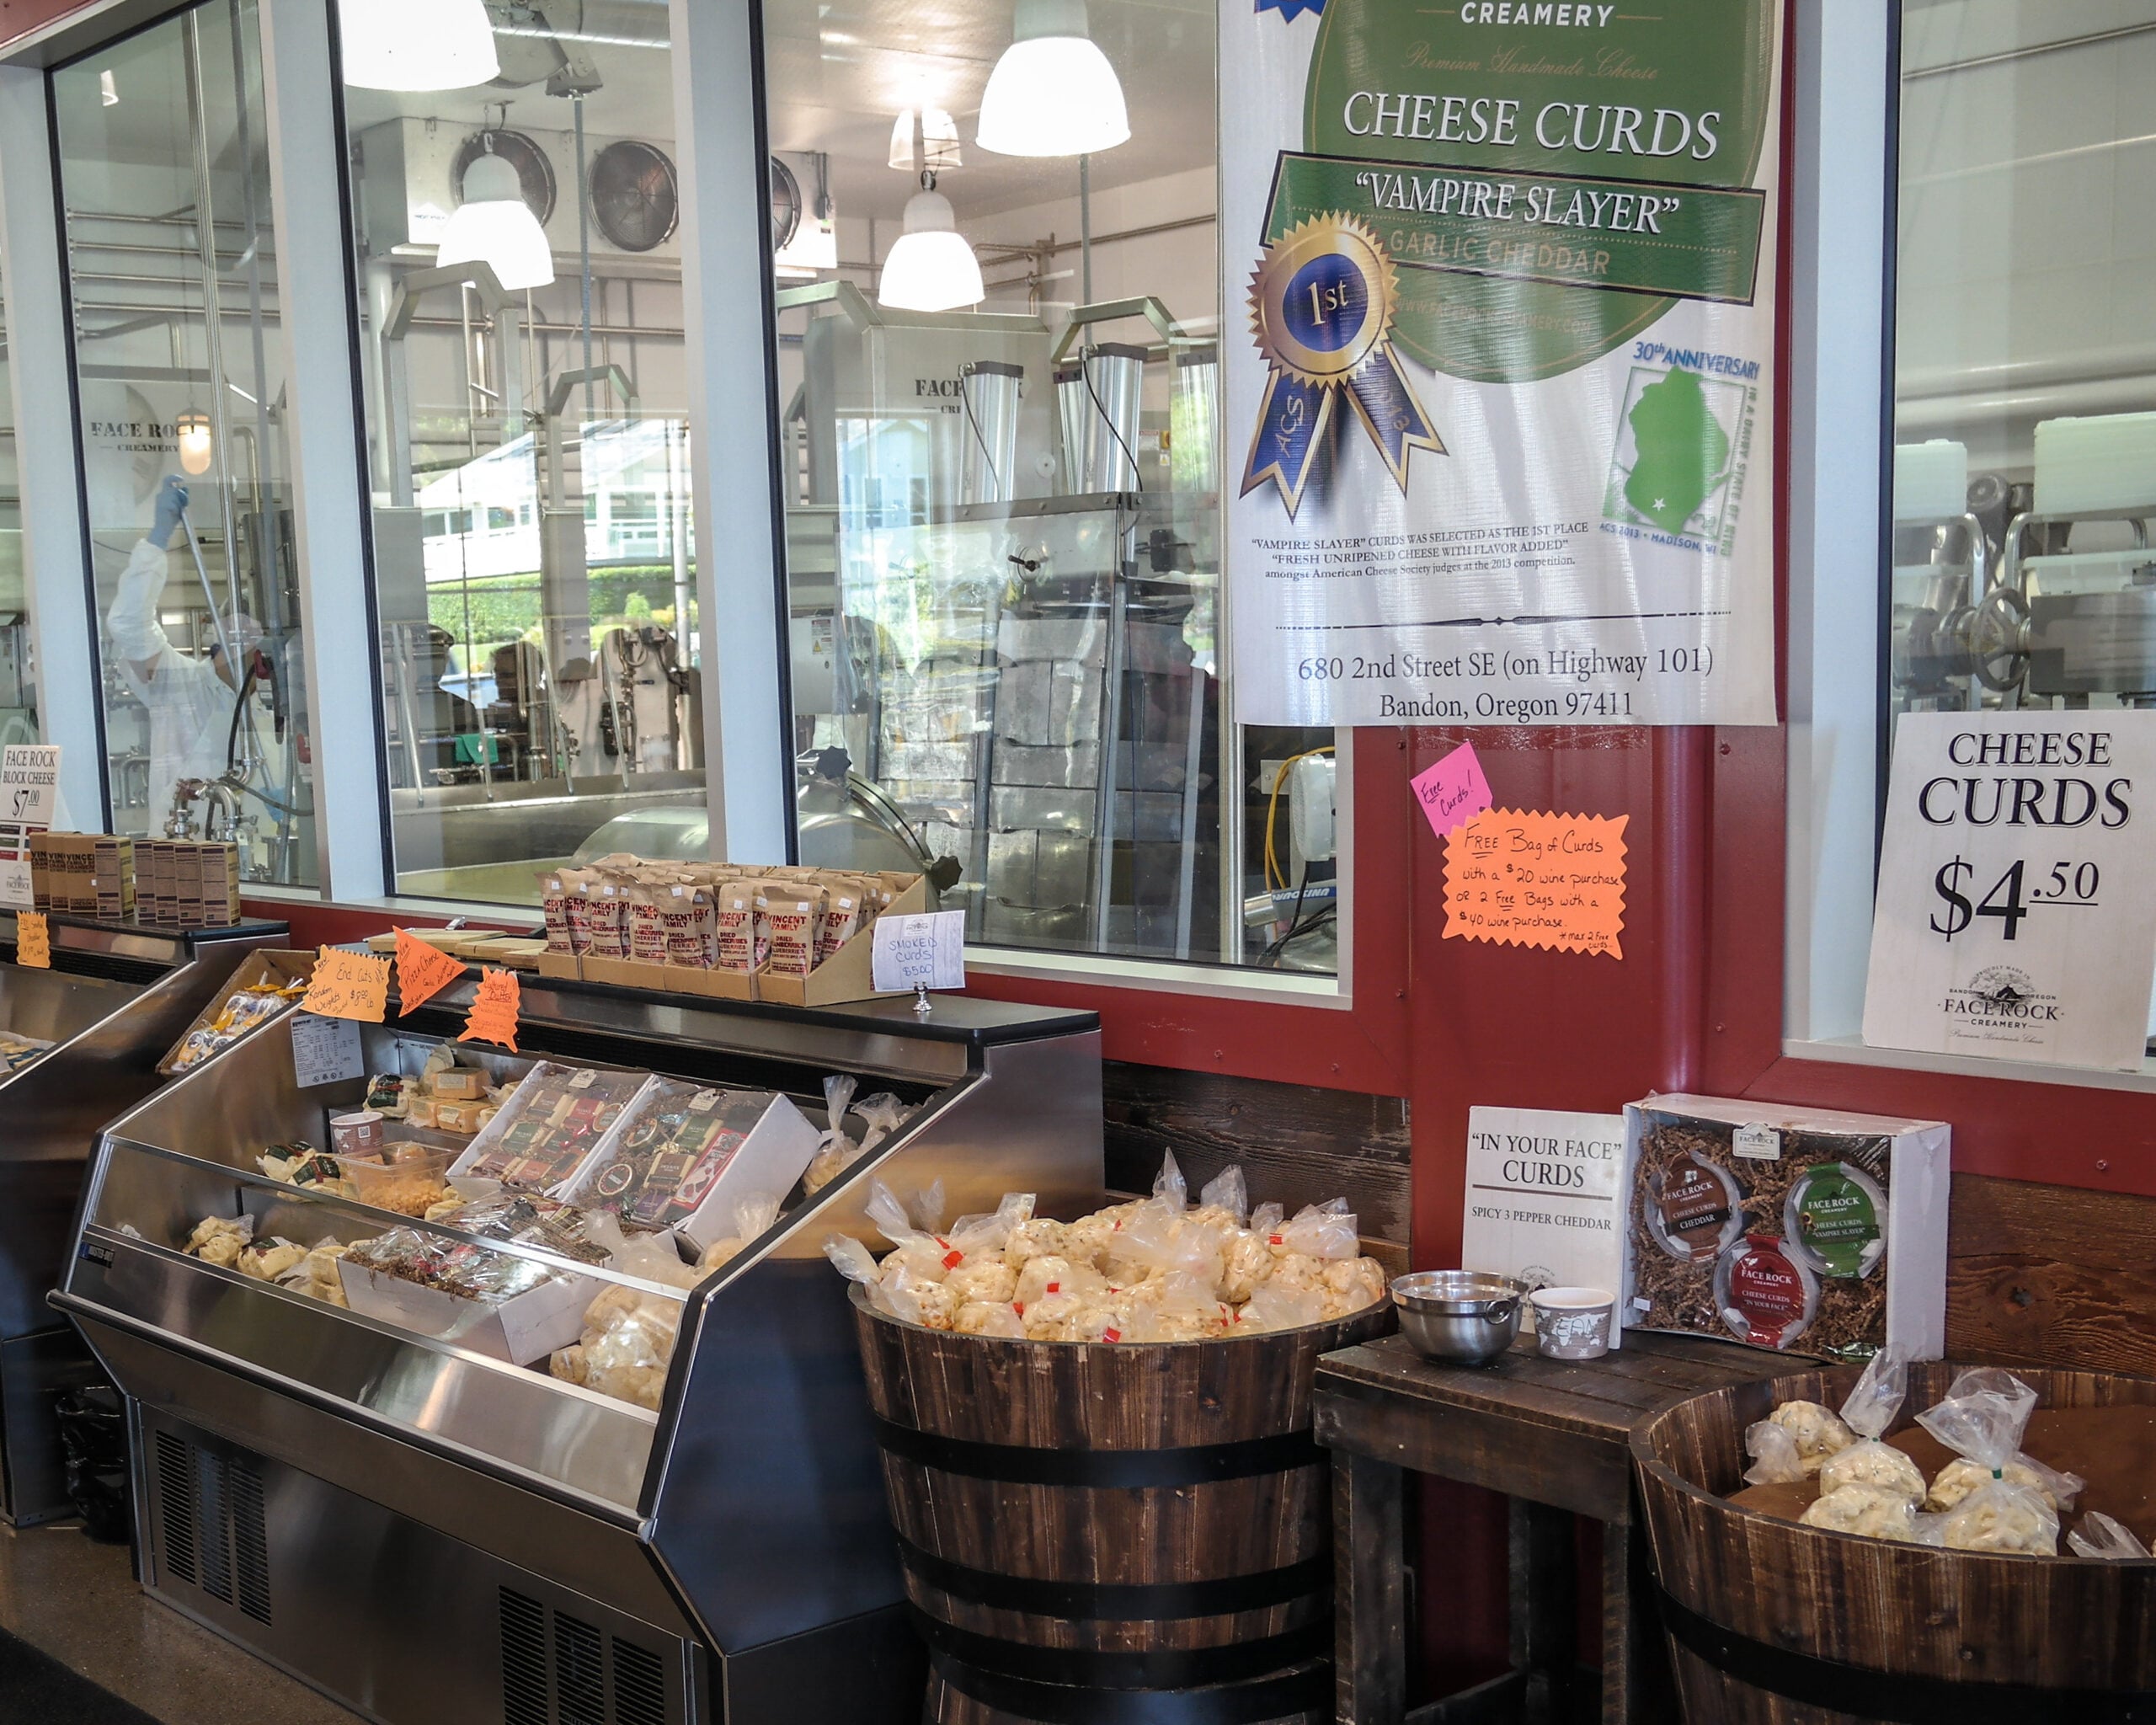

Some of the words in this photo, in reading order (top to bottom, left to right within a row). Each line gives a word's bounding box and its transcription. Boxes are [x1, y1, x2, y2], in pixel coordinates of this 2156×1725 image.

[1460, 2, 1615, 28] CREAMERY
[1401, 40, 1481, 72] Premium
[1487, 45, 1584, 77] Handmade
[1344, 91, 1519, 146] CHEESE
[1534, 102, 1721, 160] CURDS
[1390, 229, 1478, 261] GARLIC
[1486, 239, 1611, 275] CHEDDAR
[1307, 280, 1348, 327] 1st
[91, 422, 141, 438] FACE
[1276, 394, 1305, 459] ACS
[1369, 536, 1405, 547] CURDS
[1407, 533, 1428, 544] WAS
[1429, 529, 1486, 542] SELECTED
[1488, 528, 1501, 539] AS
[1503, 526, 1529, 538] THE
[1554, 521, 1589, 534] PLACE
[1599, 521, 1616, 534] ACS
[1618, 525, 1640, 539] 2013
[1324, 551, 1396, 563] UNRIPENED
[1398, 547, 1439, 559] CHEESE
[1442, 546, 1471, 557] WITH
[1474, 542, 1518, 554] FLAVOR
[1265, 570, 1310, 582] amongst
[1312, 569, 1363, 578] American
[1364, 566, 1398, 576] Cheese
[1400, 563, 1431, 576] Society
[1432, 562, 1461, 574] judges
[1464, 562, 1473, 571] at
[1475, 560, 1489, 570] the
[1492, 558, 1512, 569] 2013
[1513, 556, 1576, 569] competition.
[1298, 657, 1343, 680] 680
[1351, 654, 1396, 679] 2nd
[1402, 653, 1461, 679] Street
[1468, 652, 1496, 676] SE
[1503, 650, 1540, 681] (on
[1548, 648, 1648, 682] Highway
[1657, 644, 1714, 677] 101)
[1380, 692, 1469, 720] Bandon,
[1476, 693, 1558, 724] Oregon
[1565, 692, 1633, 717] 97411
[6, 749, 29, 767] FACE
[29, 750, 56, 768] ROCK
[1948, 732, 2112, 767] CHEESE
[3, 769, 26, 784] BLOCK
[28, 771, 55, 785] CHEESE
[1421, 781, 1444, 800] Free
[1918, 777, 2132, 830] CURDS
[1465, 822, 1499, 849] FREE
[1506, 828, 1542, 860] Bag
[1547, 837, 1558, 852] of
[1561, 829, 1604, 854] Curds
[1463, 867, 1486, 880] with
[1492, 872, 1500, 881] a
[1506, 862, 1534, 884] $20
[1540, 869, 1565, 884] wine
[1569, 870, 1619, 889] purchase
[1480, 891, 1488, 902] 2
[1496, 890, 1515, 904] Free
[1524, 891, 1554, 911] Bags
[1560, 893, 1584, 907] with
[1590, 899, 1598, 908] a
[1929, 854, 2100, 943] $4.50
[1460, 911, 1483, 926] $40
[1487, 914, 1509, 927] wine
[889, 936, 937, 951] SMOKED
[336, 962, 352, 980] End
[357, 968, 372, 983] Cuts
[1943, 998, 1994, 1016] FACE
[2000, 1002, 2060, 1021] ROCK
[1971, 1018, 2028, 1029] CREAMERY
[1506, 1135, 1559, 1156] YOUR
[1502, 1159, 1584, 1188] CURDS
[1668, 1188, 1688, 1200] FACE
[1688, 1181, 1714, 1194] ROCK
[1673, 1209, 1694, 1219] CHEESE
[1695, 1202, 1717, 1213] CURDS
[1807, 1199, 1831, 1210] FACE
[1832, 1197, 1860, 1207] ROCK
[1471, 1205, 1502, 1220] SPICY
[1504, 1210, 1510, 1220] 3
[1513, 1210, 1552, 1225] PEPPER
[1555, 1215, 1612, 1231] CHEDDAR
[1679, 1214, 1716, 1230] CHEDDAR
[1816, 1220, 1838, 1229] HEESE
[1741, 1269, 1764, 1279] FACE
[1765, 1273, 1792, 1284] ROCK
[1742, 1290, 1767, 1299] CHEESE
[1767, 1294, 1790, 1303] CURDS
